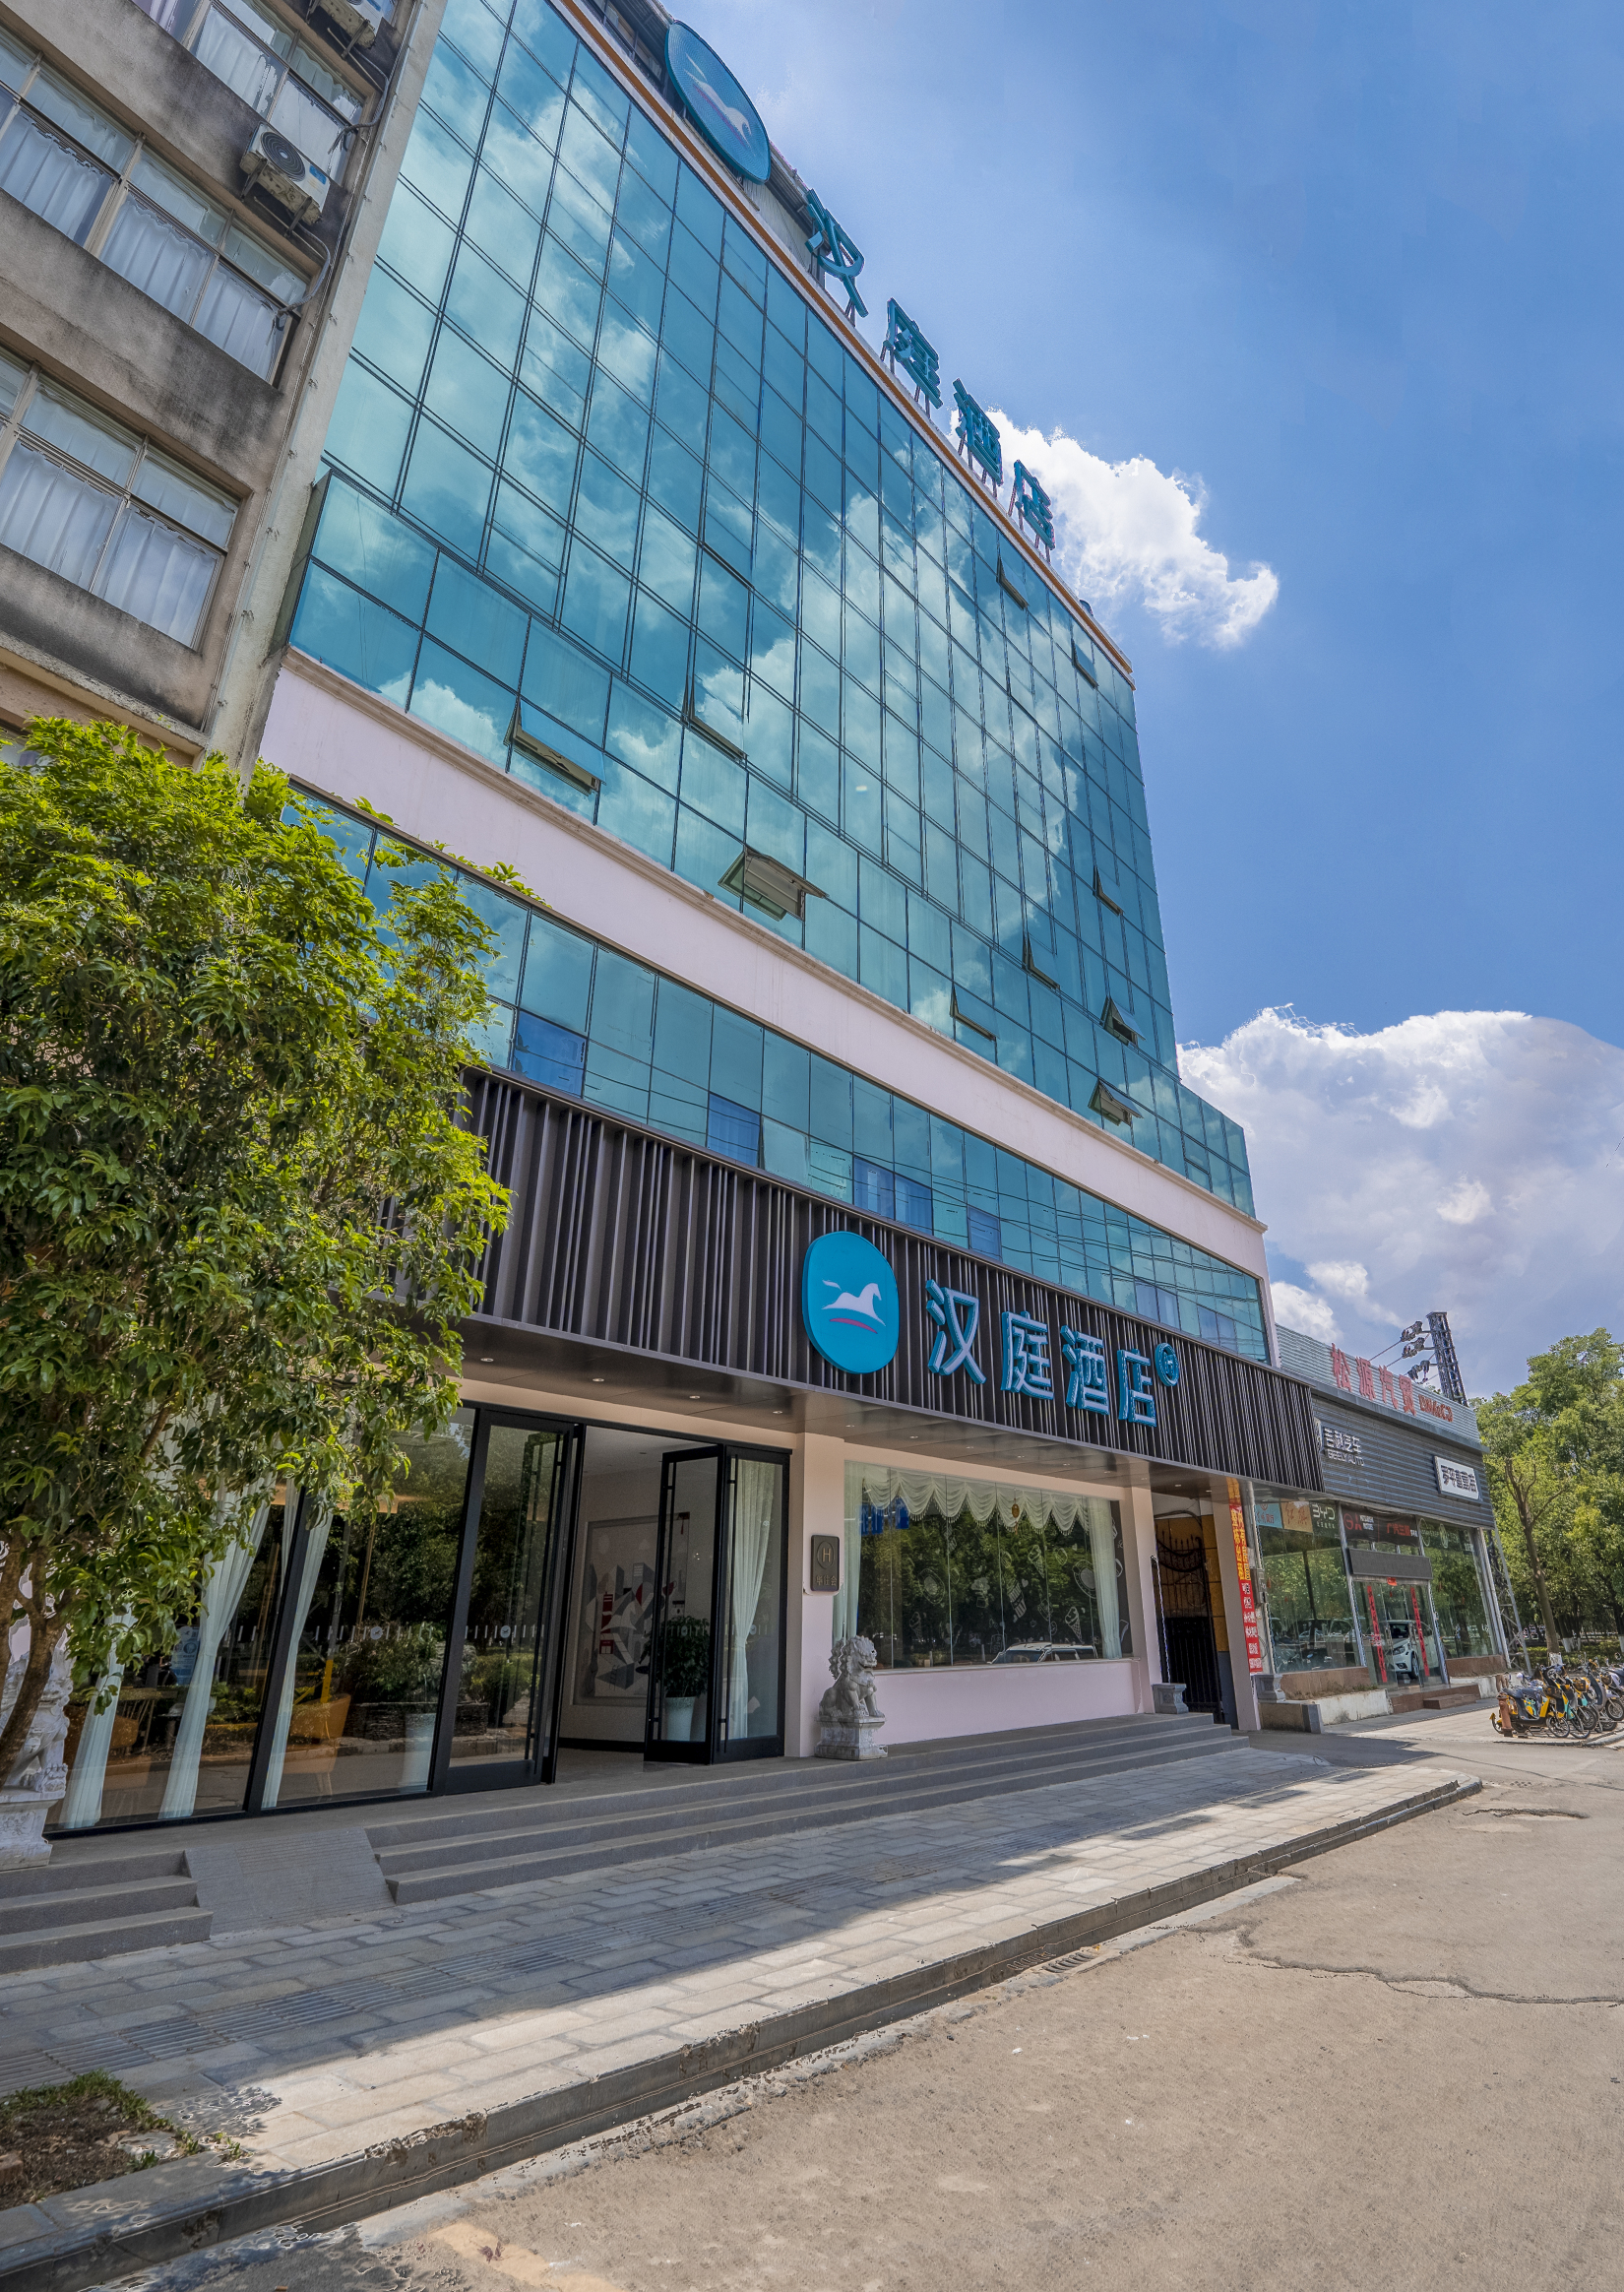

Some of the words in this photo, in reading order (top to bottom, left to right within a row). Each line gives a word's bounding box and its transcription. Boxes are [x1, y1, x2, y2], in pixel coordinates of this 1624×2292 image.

[804, 188, 1056, 550] 汉庭酒店
[925, 1279, 1157, 1428] 汉庭酒店
[1348, 1454, 1365, 1467] AUTO
[1312, 1502, 1336, 1520] BYD
[816, 1575, 837, 1586] 华住会
